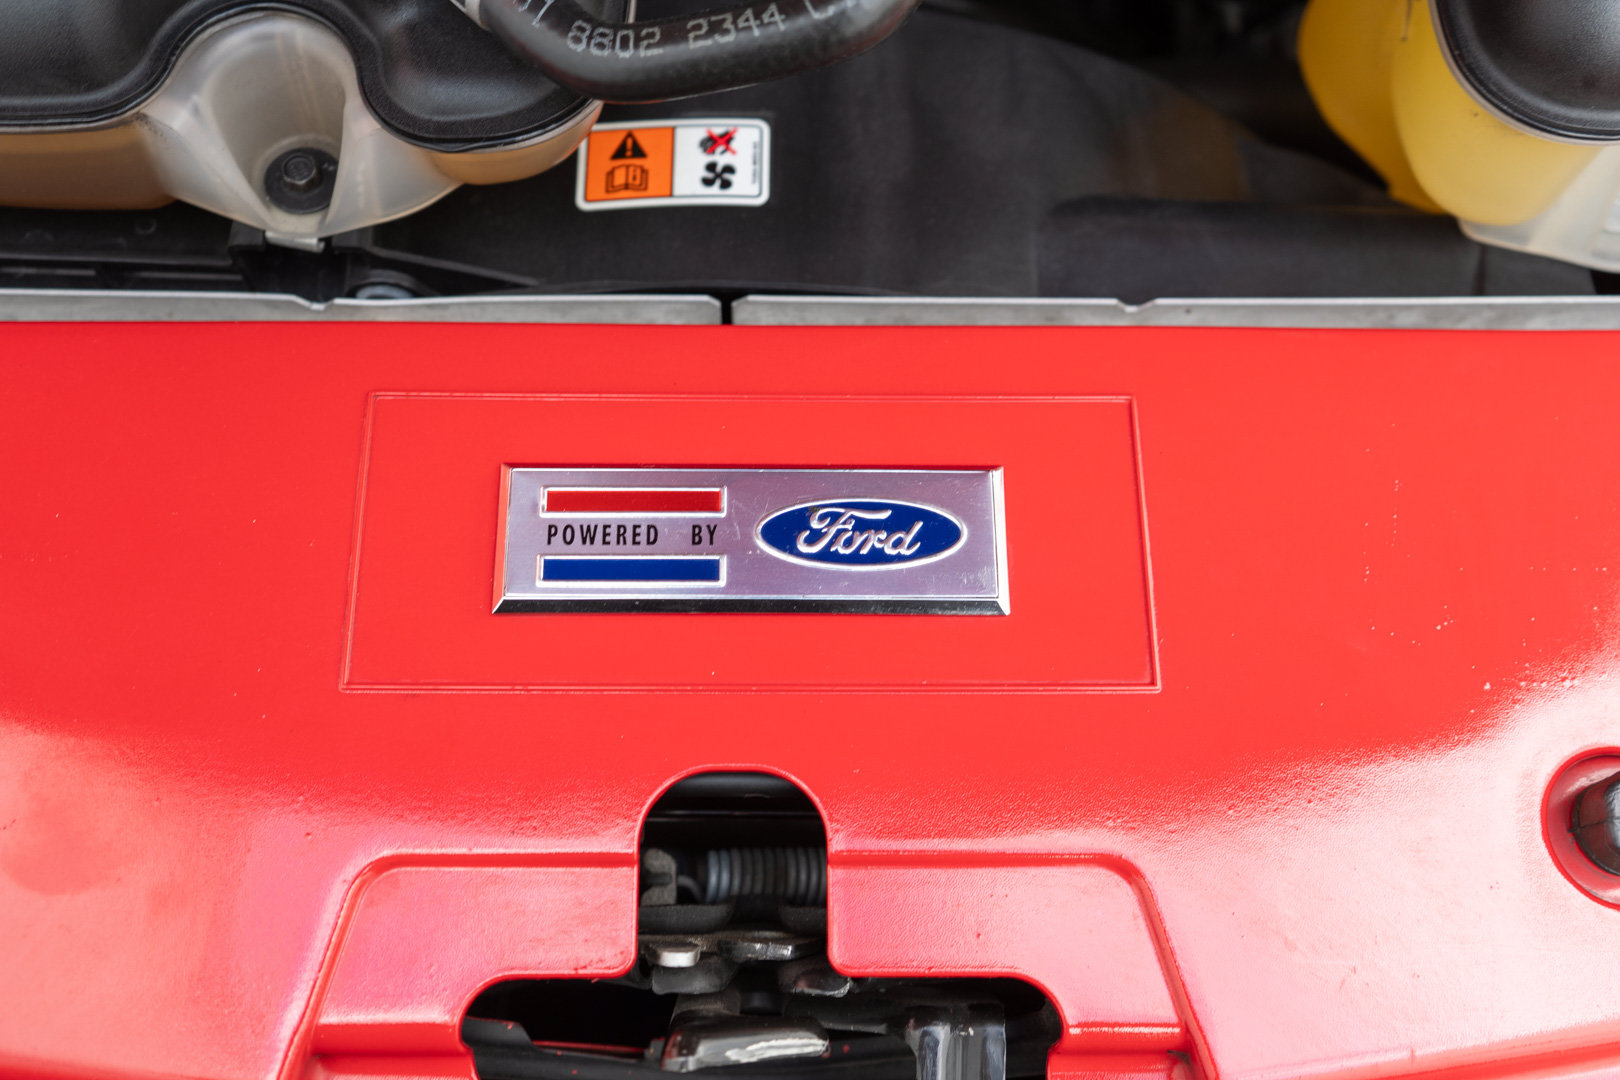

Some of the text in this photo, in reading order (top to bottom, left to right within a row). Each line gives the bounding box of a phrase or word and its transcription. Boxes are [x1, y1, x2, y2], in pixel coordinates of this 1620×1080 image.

[567, 19, 664, 58] 8802
[687, 3, 787, 48] 2344
[547, 524, 718, 546] POWERED BY
[796, 507, 924, 556] Ford
